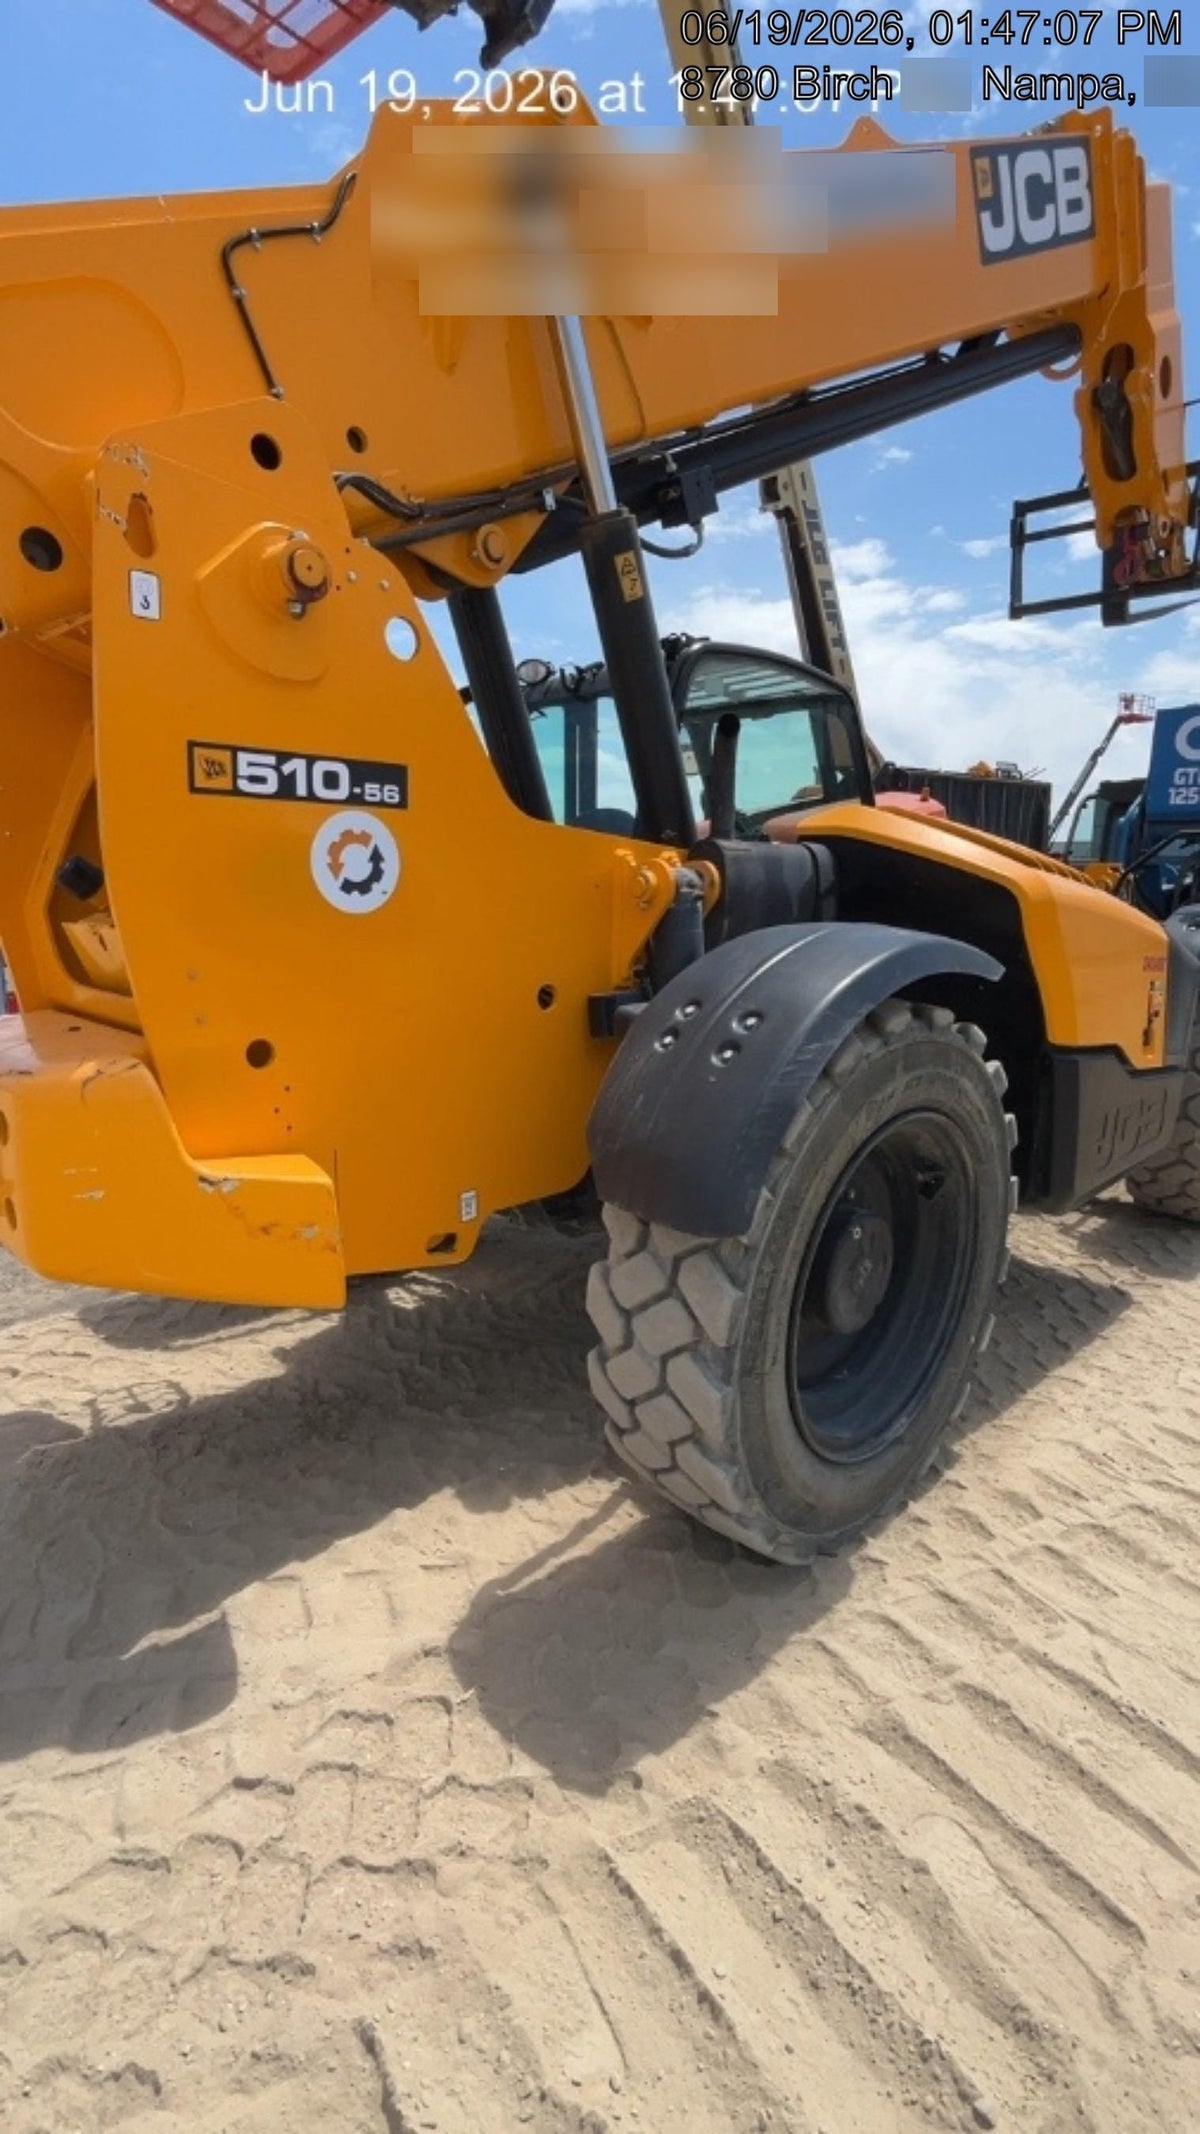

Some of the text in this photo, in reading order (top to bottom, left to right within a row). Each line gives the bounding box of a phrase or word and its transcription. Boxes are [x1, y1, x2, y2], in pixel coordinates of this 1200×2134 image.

[979, 146, 1092, 252] JCB
[800, 500, 848, 653] JLG LIFT
[236, 751, 400, 804] 510-56
[1173, 768, 1200, 786] GT
